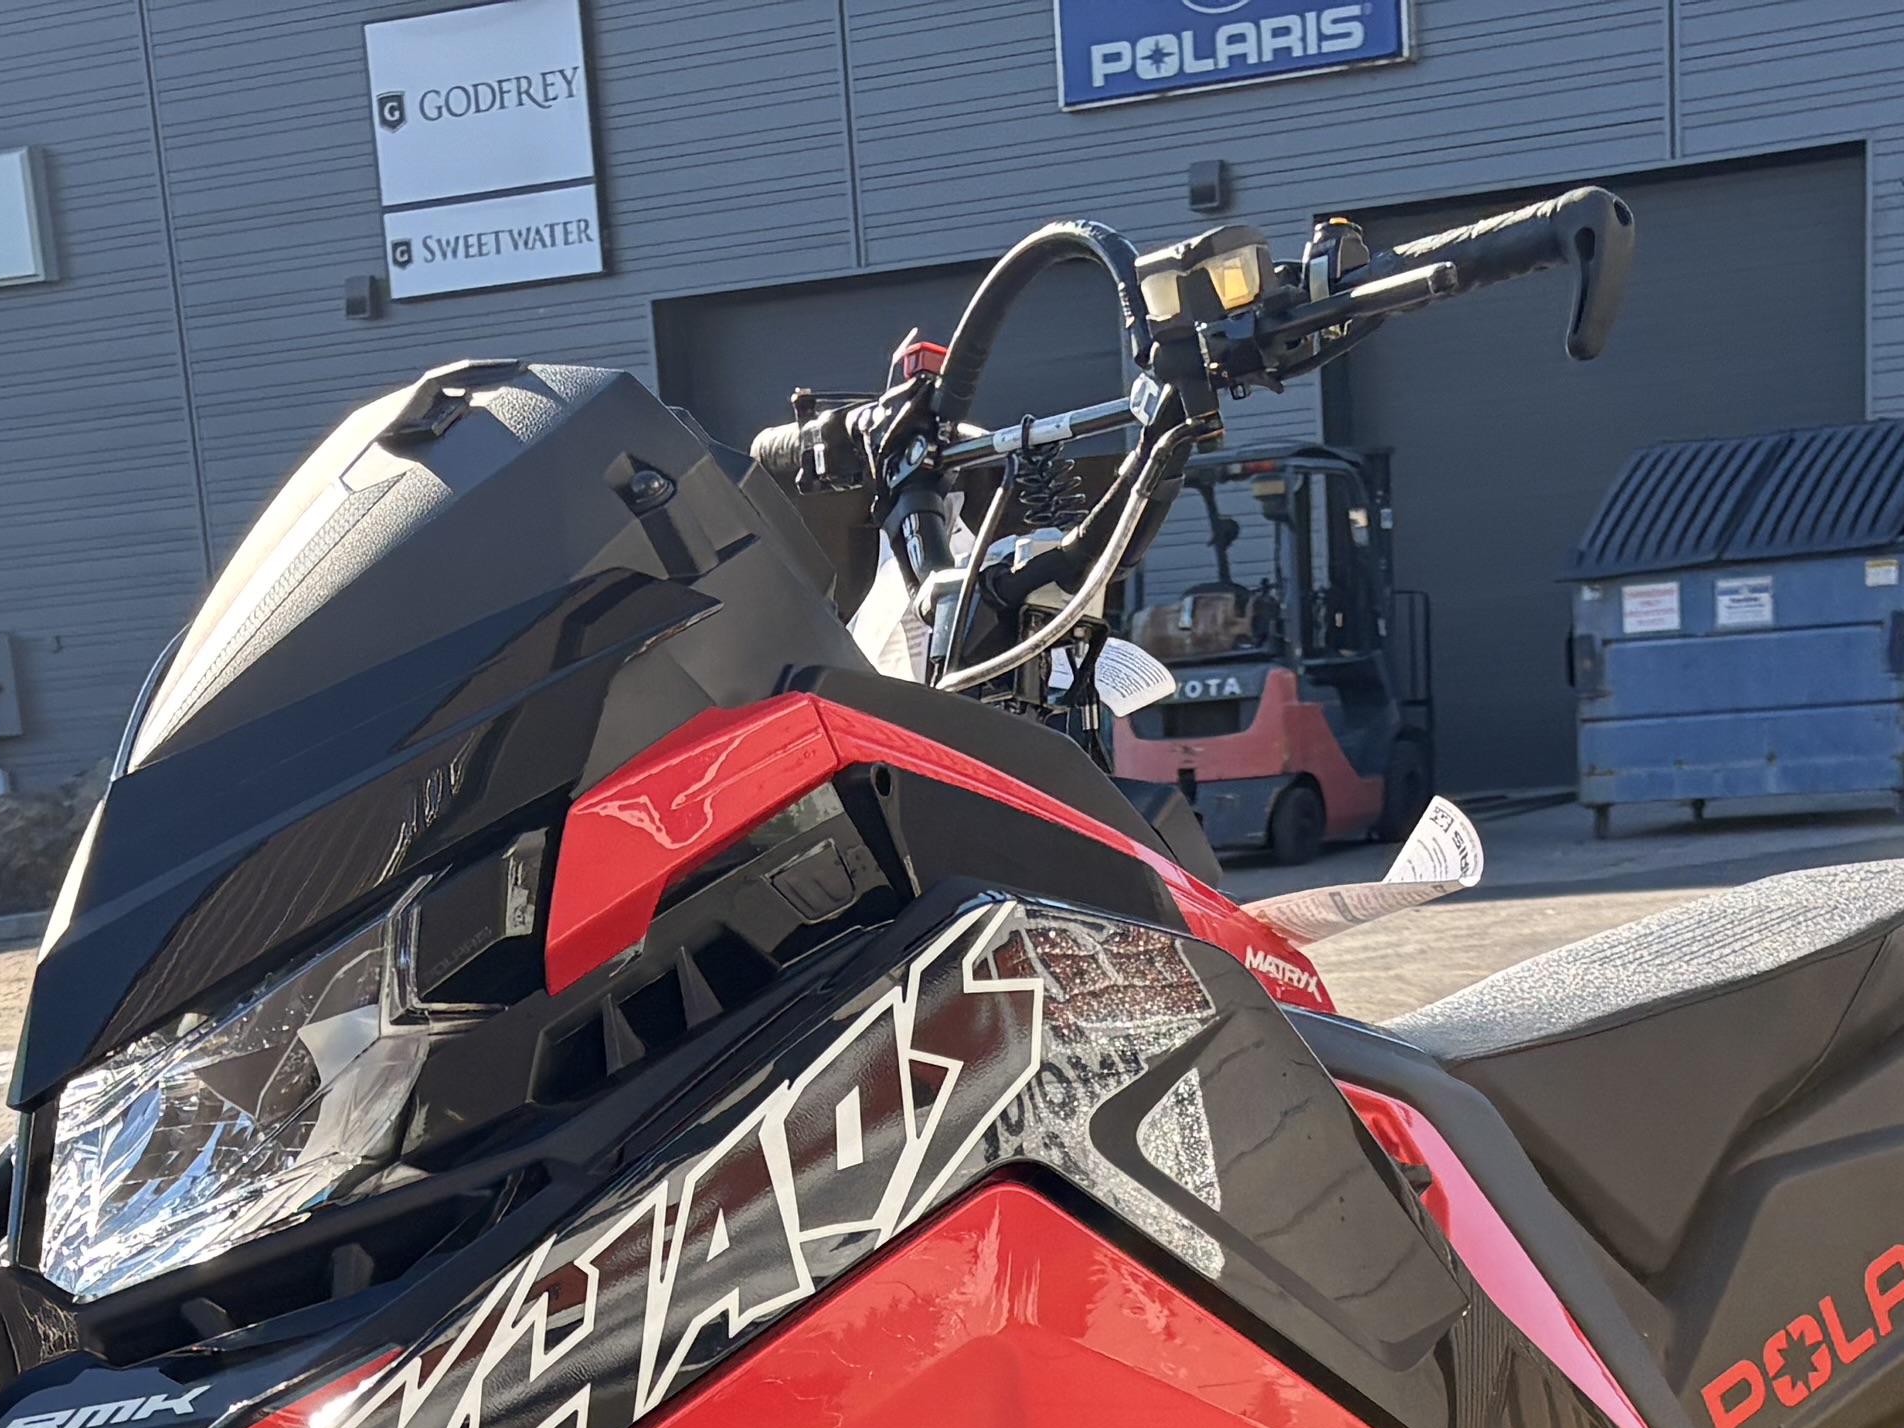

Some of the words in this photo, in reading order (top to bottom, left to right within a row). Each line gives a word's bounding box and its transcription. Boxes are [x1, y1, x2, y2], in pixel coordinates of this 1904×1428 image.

[1090, 5, 1364, 88] POLARIS
[419, 66, 580, 122] GODFREY
[422, 218, 593, 263] SWEETWATER
[1245, 946, 1322, 1003] MATRYX
